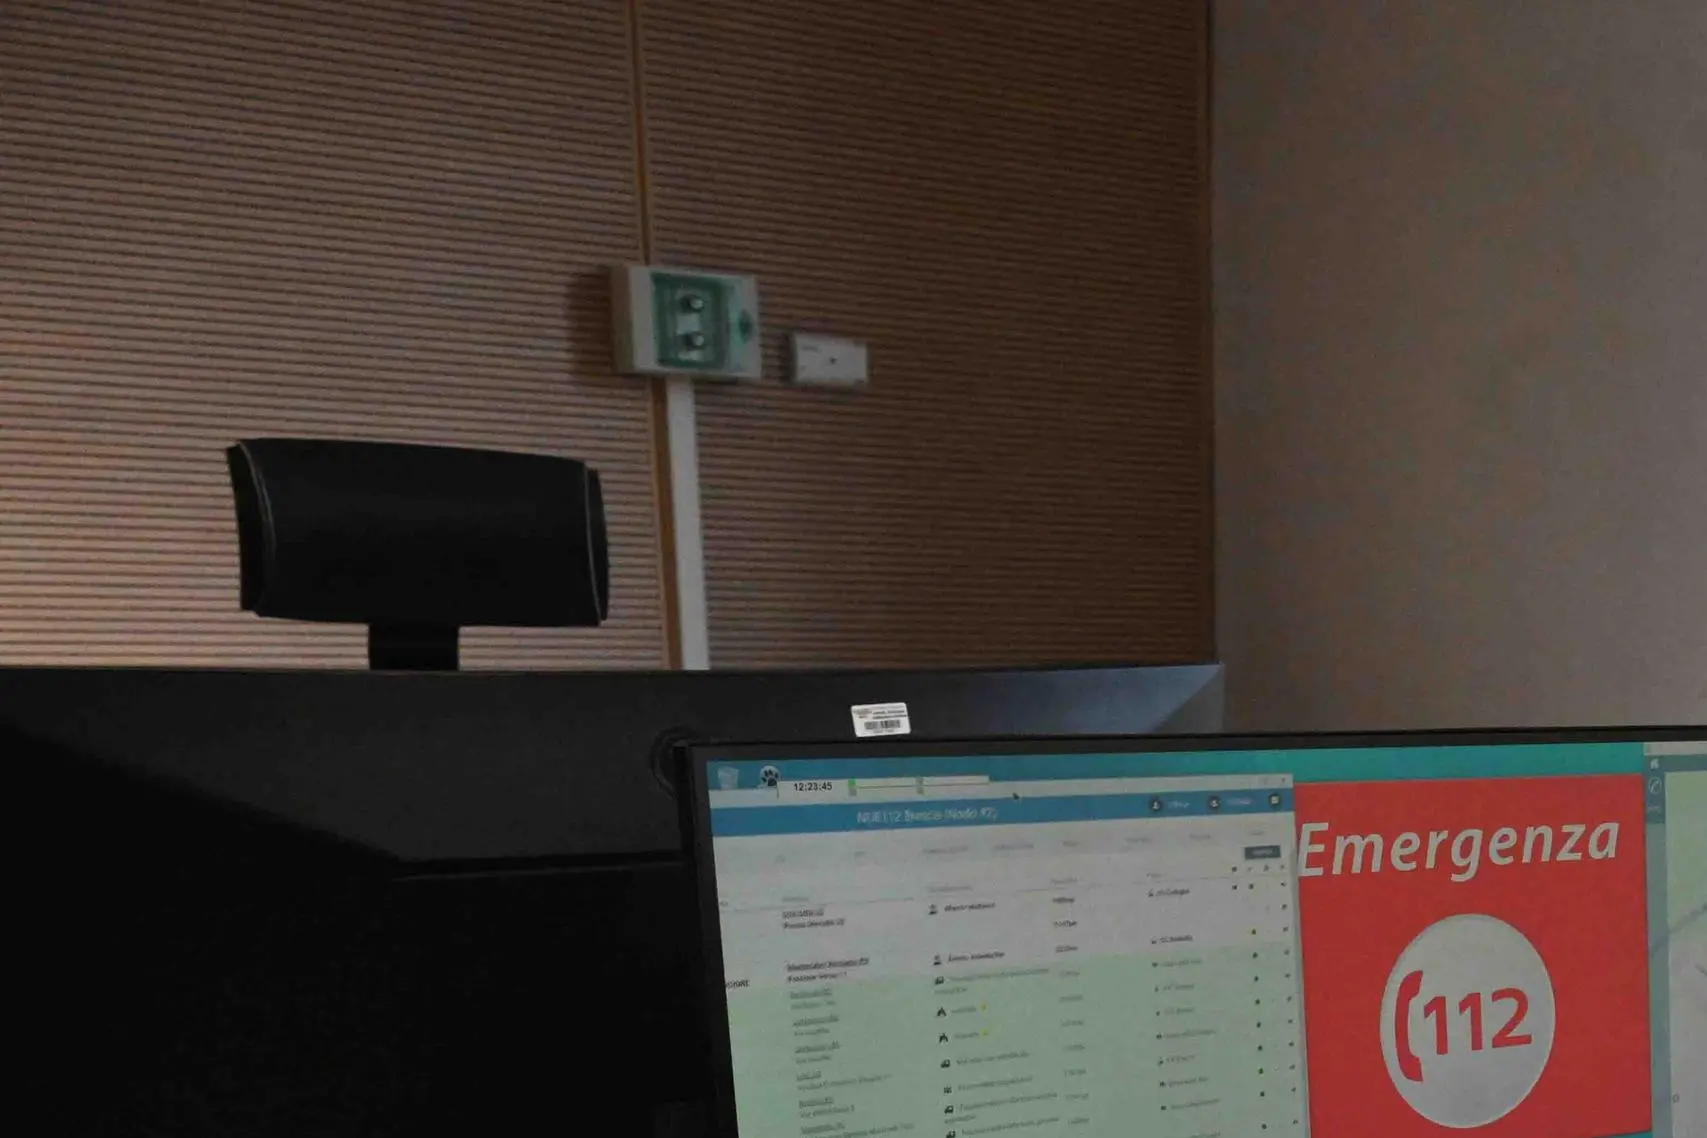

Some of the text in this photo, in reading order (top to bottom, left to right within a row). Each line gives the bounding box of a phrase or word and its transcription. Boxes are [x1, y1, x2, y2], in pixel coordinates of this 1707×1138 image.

[794, 781, 833, 792] 12:23:45
[1298, 820, 1620, 882] Emergenza
[1423, 987, 1533, 1056] 112
